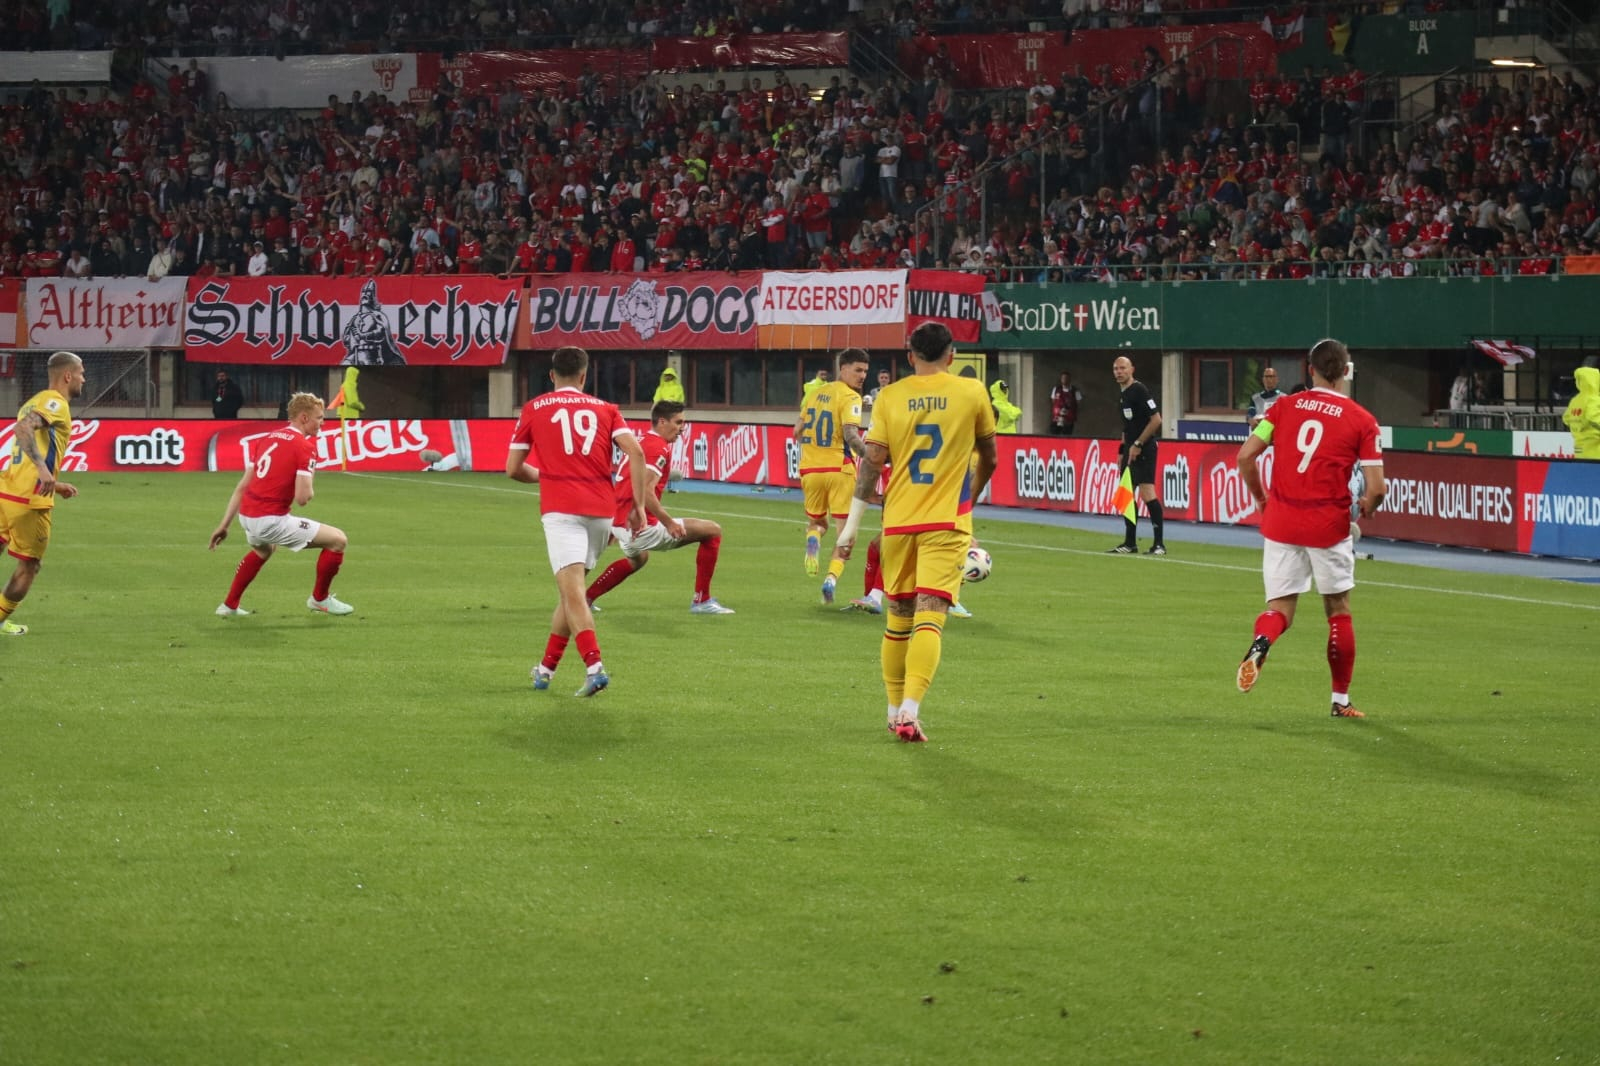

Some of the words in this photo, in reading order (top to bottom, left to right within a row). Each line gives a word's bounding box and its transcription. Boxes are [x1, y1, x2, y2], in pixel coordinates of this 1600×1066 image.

[1164, 31, 1194, 43] STIEGE
[1409, 20, 1438, 32] BLOCK
[1018, 38, 1045, 49] BLOCK
[1417, 33, 1429, 55] A
[374, 59, 401, 70] BLOCK
[1025, 52, 1038, 71] H
[382, 71, 394, 91] G
[763, 283, 900, 311] ATZGERSDORF
[909, 290, 951, 318] VIVA
[1091, 296, 1161, 331] Wien
[533, 396, 605, 411] BAUMGARTNER
[1295, 398, 1343, 417] SABITZER
[551, 408, 598, 455] 19
[801, 407, 834, 447] 20
[117, 430, 183, 463] mit
[256, 441, 278, 478] 6
[908, 423, 944, 485] 2
[1296, 419, 1324, 474] 9
[1017, 454, 1045, 498] Teile
[1048, 456, 1074, 500] dein
[1164, 459, 1189, 506] mit
[1377, 478, 1434, 516] ROPEAN
[1437, 481, 1513, 525] QUALIFIERS
[1524, 492, 1552, 523] FIFA
[1552, 494, 1600, 526] WORLD
